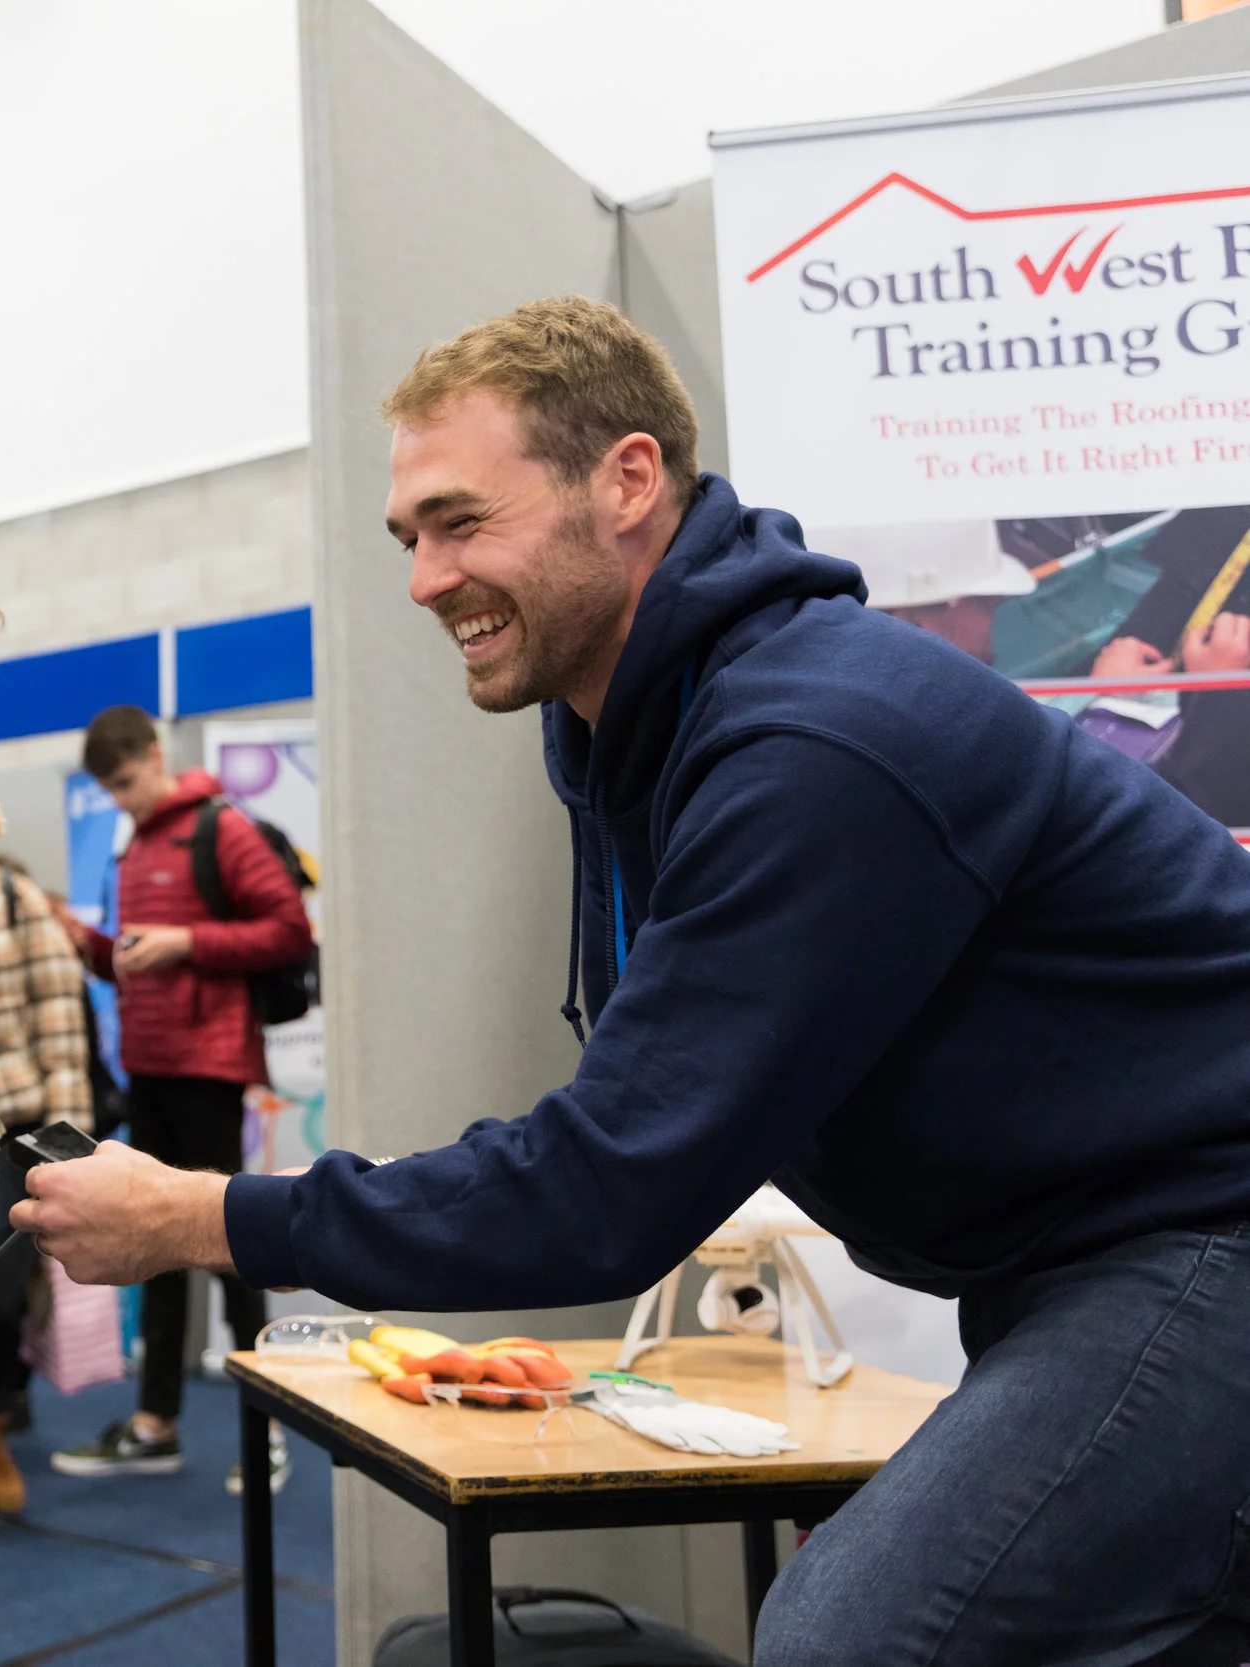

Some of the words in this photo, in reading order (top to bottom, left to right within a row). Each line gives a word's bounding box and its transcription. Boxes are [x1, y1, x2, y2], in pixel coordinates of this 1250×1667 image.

[799, 245, 998, 315] South
[1016, 222, 1196, 297] West
[852, 315, 1161, 377] Training
[1175, 298, 1250, 356] G
[870, 409, 1023, 440] Training
[1031, 405, 1097, 431] The
[1111, 395, 1250, 427] Roofing
[916, 454, 960, 480] To
[970, 449, 1028, 479] Get
[1042, 448, 1068, 475] It
[1080, 442, 1177, 475] Right
[1193, 436, 1250, 465] Fir
